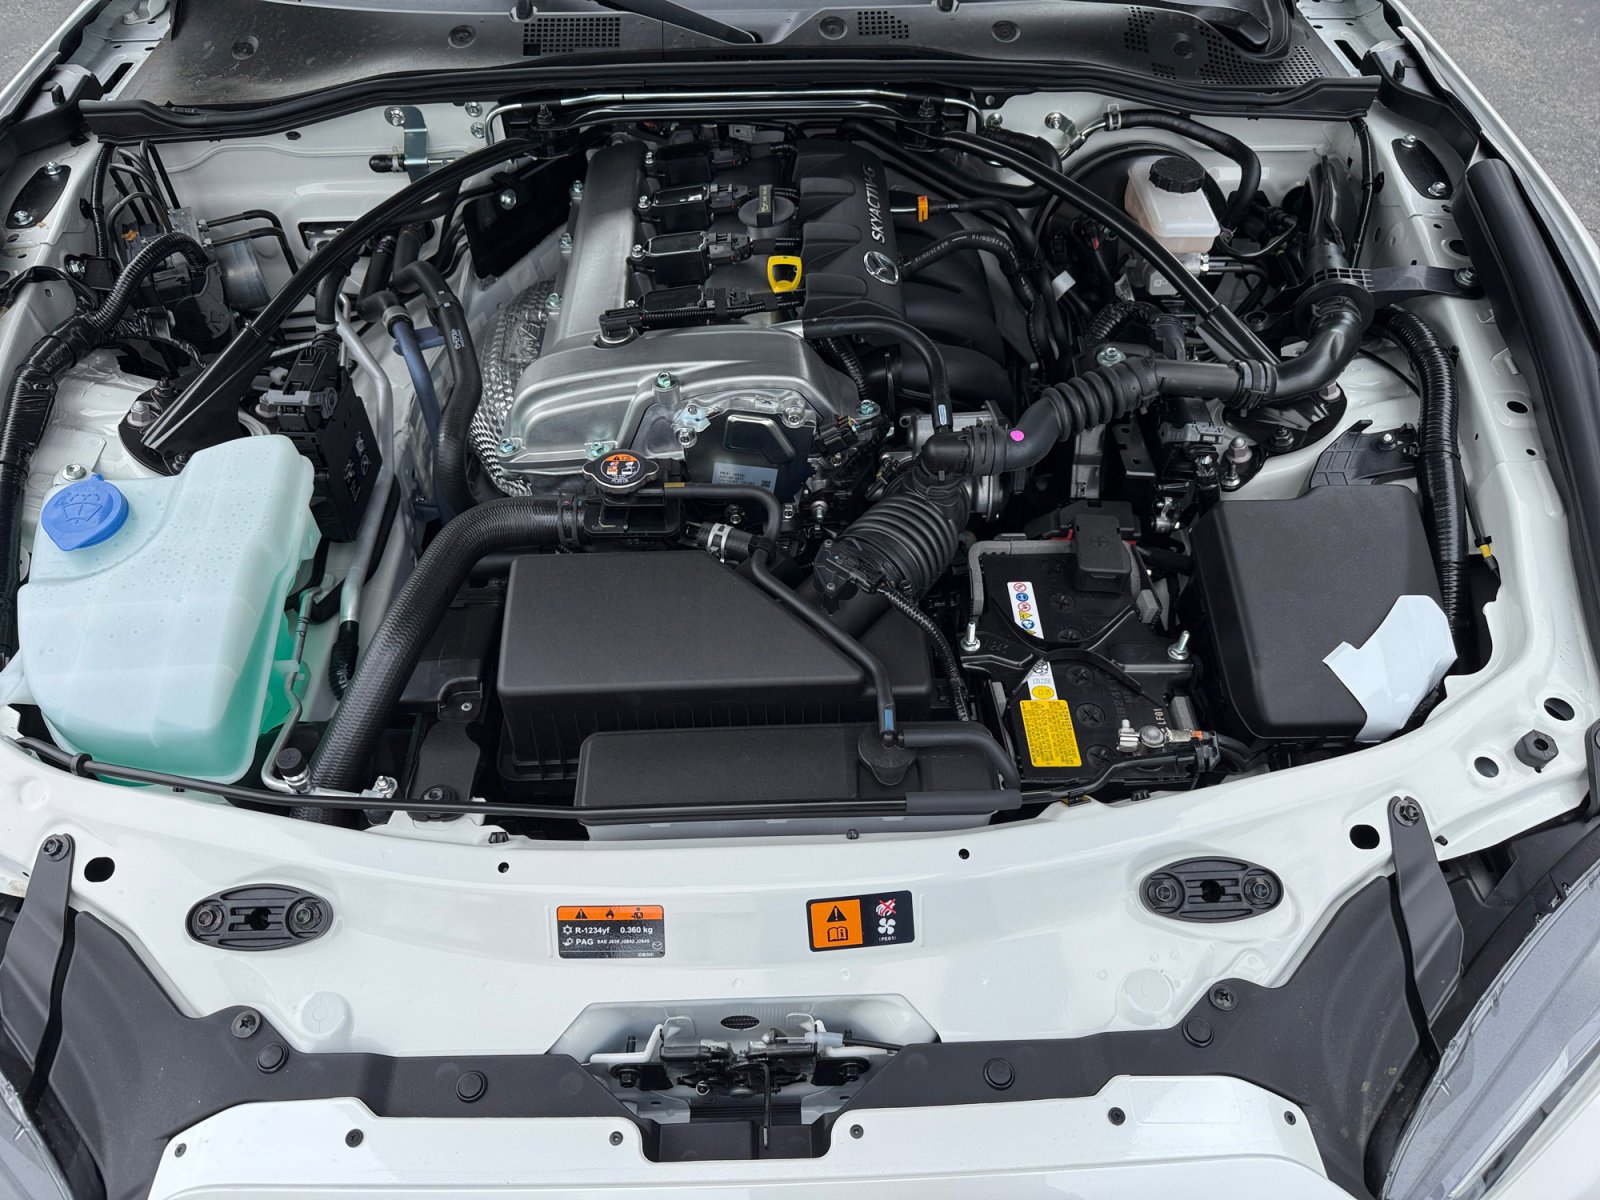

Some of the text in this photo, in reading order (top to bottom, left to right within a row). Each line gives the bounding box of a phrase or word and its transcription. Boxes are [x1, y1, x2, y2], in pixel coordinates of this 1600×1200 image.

[862, 164, 885, 244] SKYACTIV-G
[575, 926, 653, 935] R-1234yf 0.360 kg
